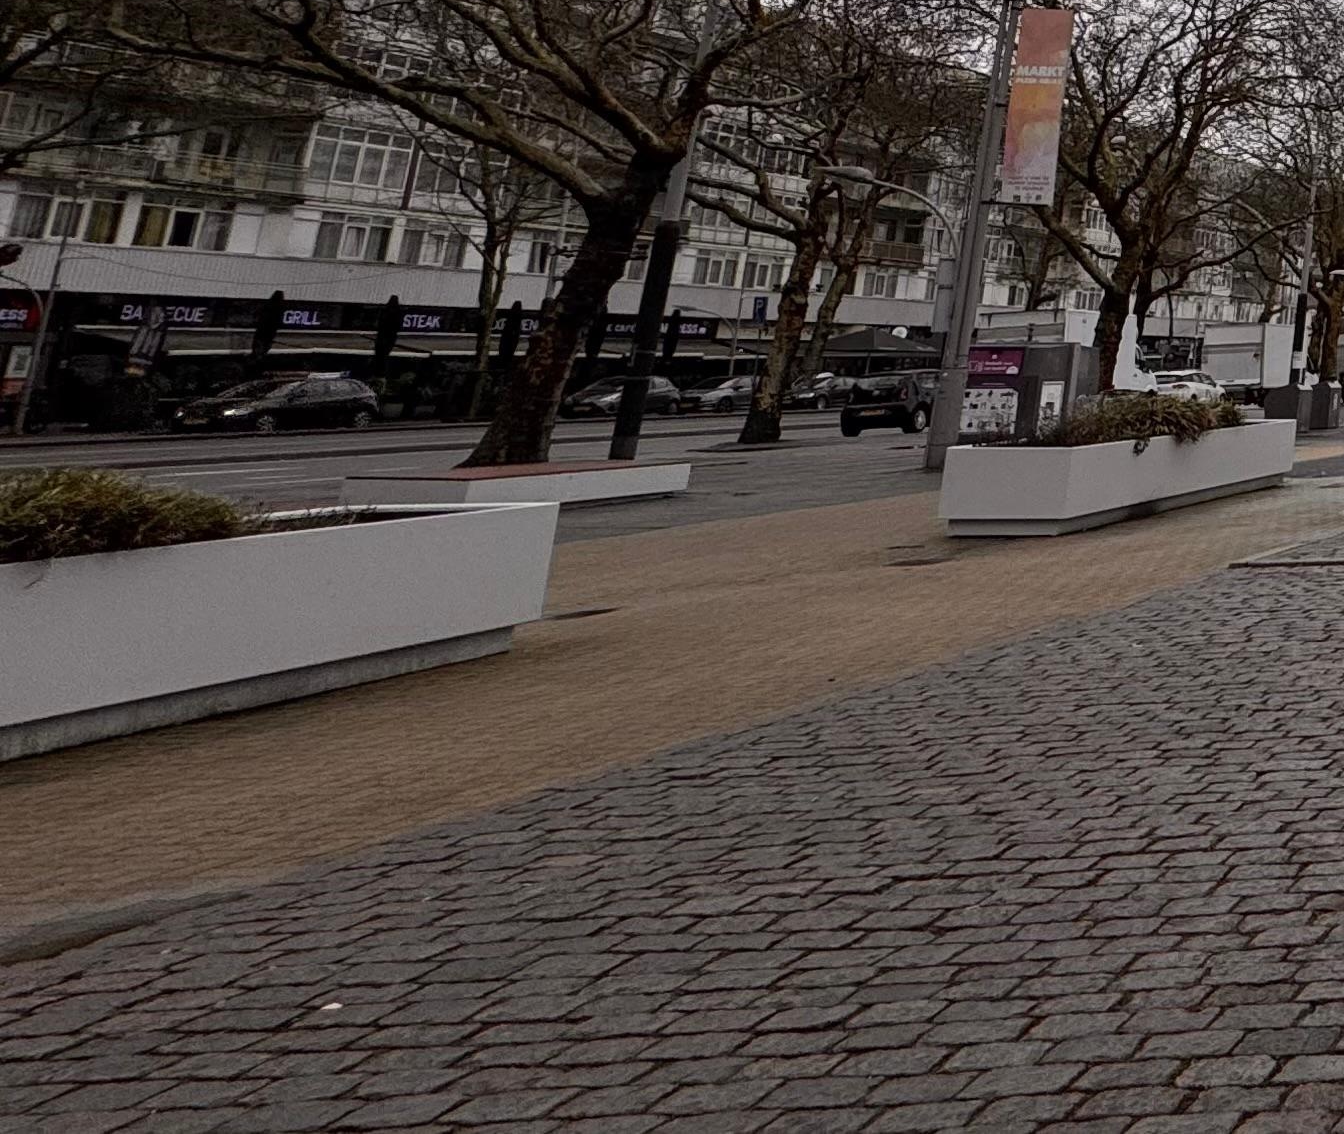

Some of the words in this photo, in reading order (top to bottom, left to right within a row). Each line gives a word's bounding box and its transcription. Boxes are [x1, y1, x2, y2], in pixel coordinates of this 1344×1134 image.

[1015, 65, 1065, 77] MARKT
[119, 304, 209, 323] BAECUE
[755, 299, 764, 314] P
[282, 309, 321, 326] GRILL
[402, 313, 441, 329] STEAK
